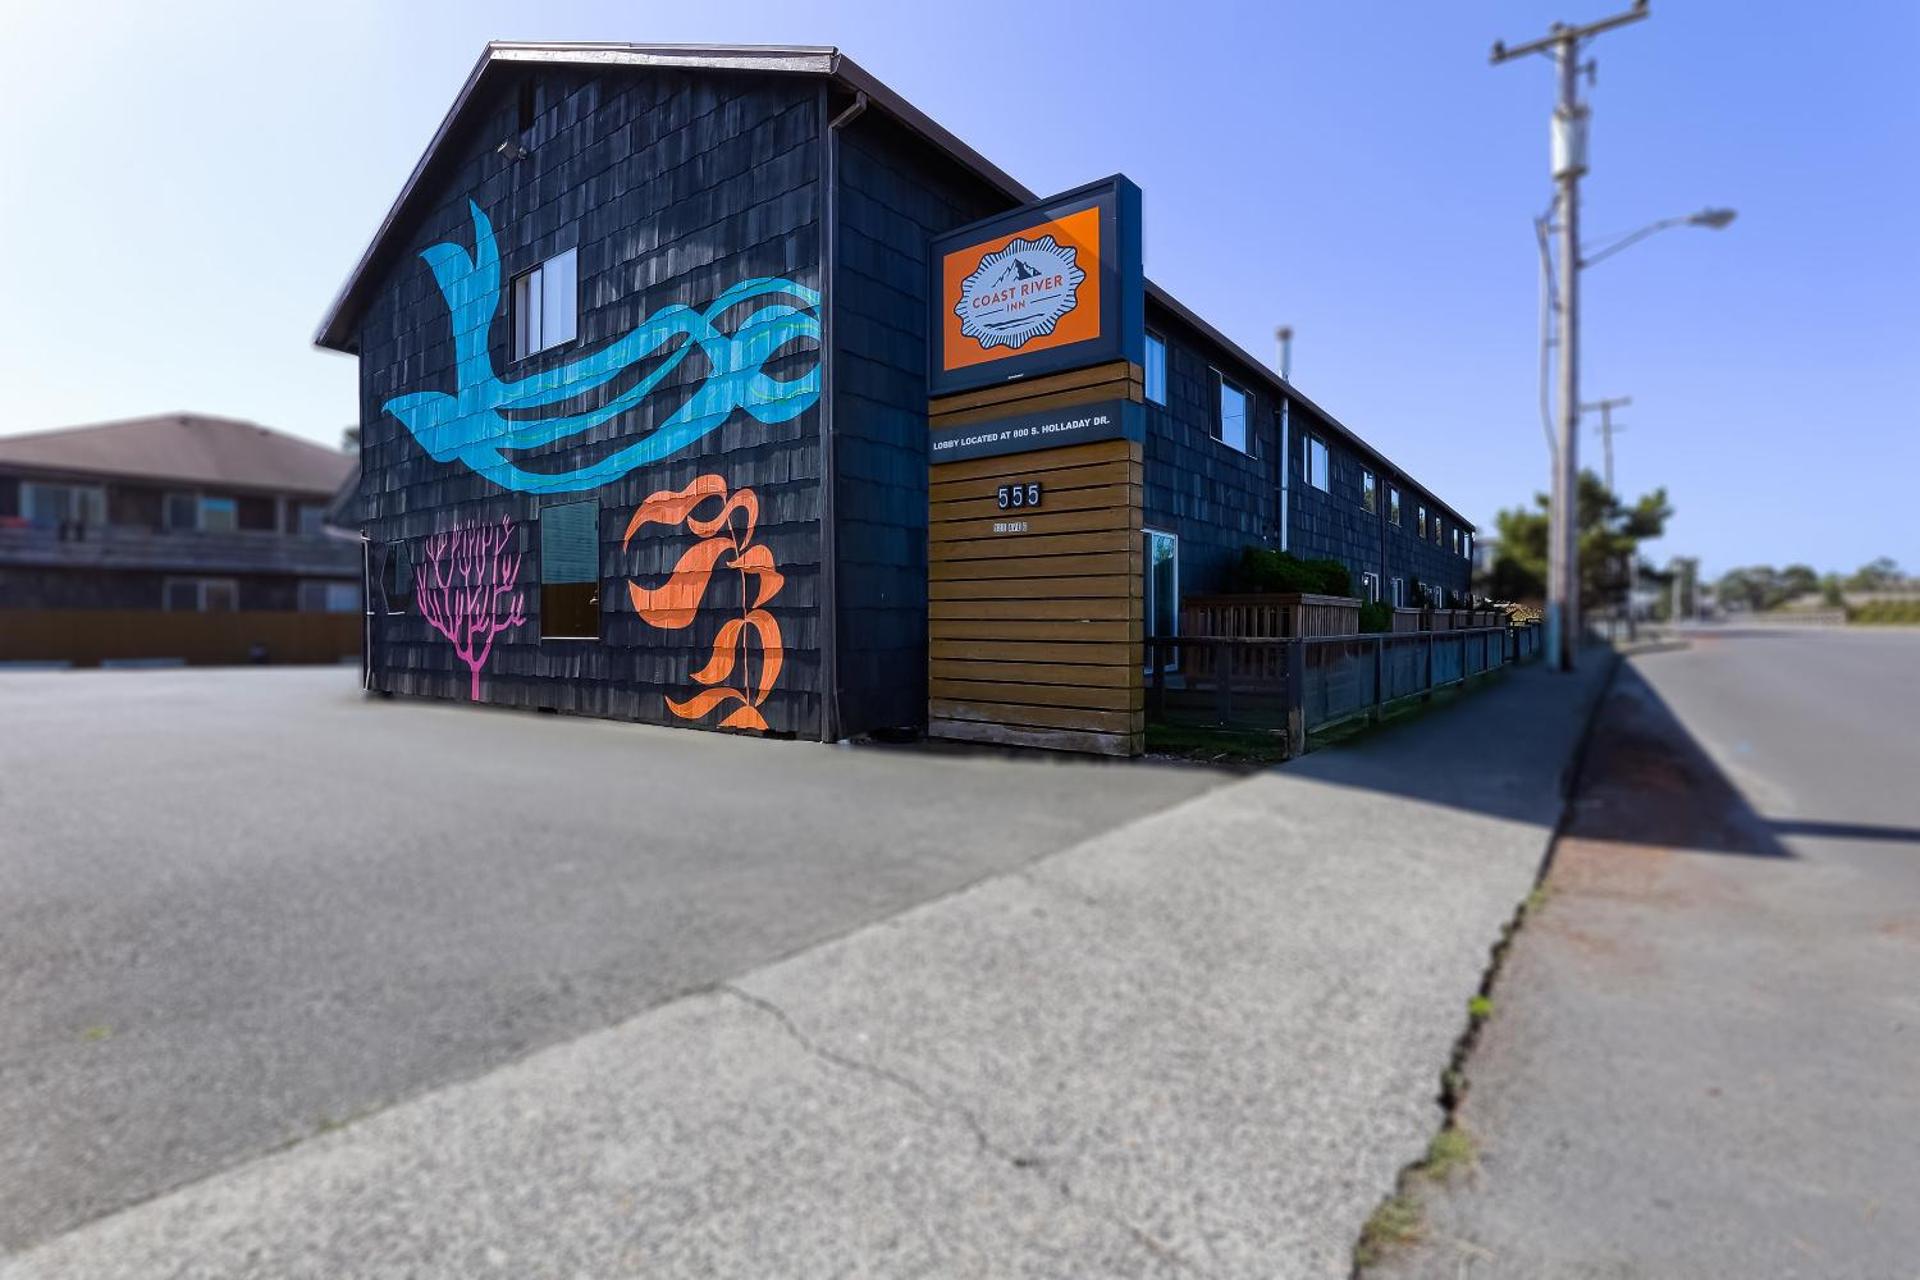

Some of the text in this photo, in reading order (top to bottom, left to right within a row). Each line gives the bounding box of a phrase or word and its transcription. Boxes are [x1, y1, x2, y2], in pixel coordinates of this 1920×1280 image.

[972, 274, 1063, 309] COAST RIVER
[1006, 300, 1025, 312] INN
[933, 415, 1110, 450] LOBBY LOCATED AT 800 S. HOLLADAY DR.
[999, 484, 1040, 508] 555
